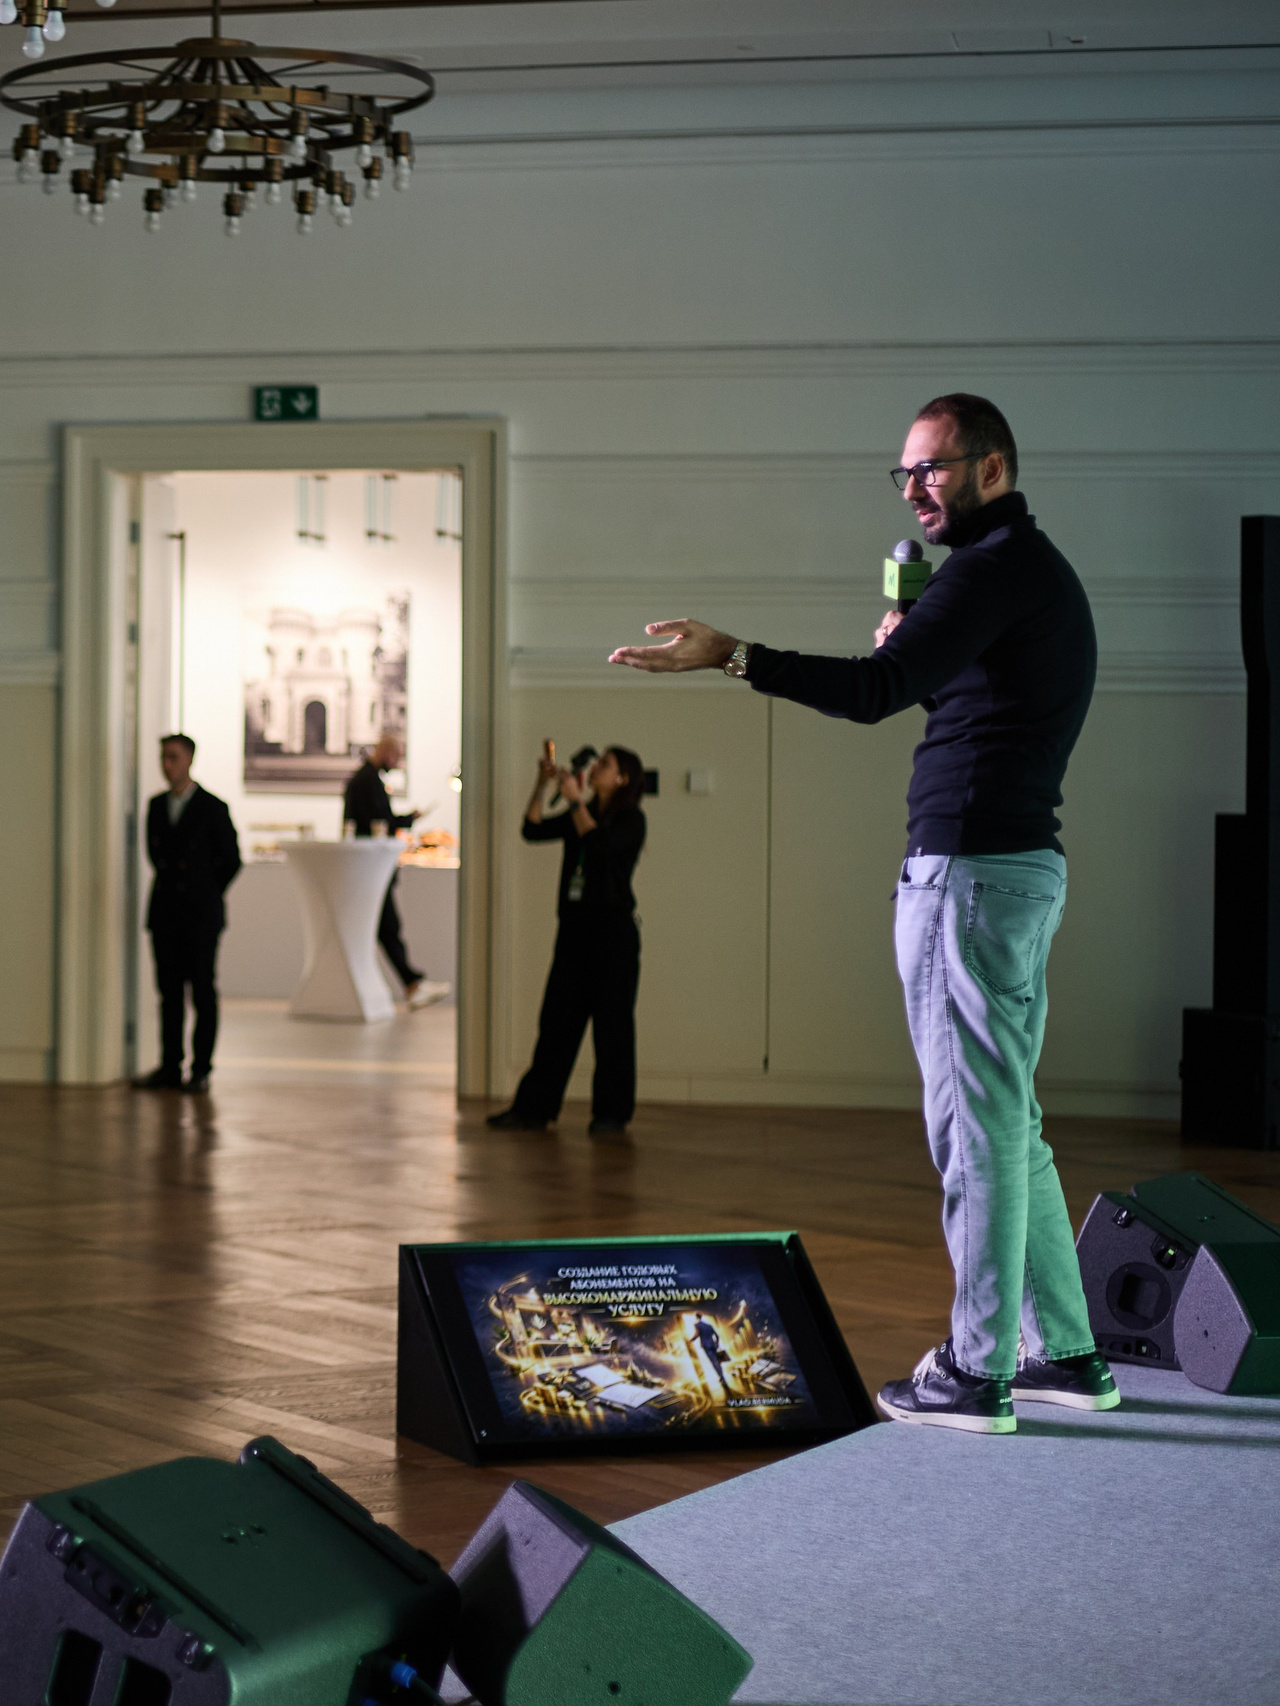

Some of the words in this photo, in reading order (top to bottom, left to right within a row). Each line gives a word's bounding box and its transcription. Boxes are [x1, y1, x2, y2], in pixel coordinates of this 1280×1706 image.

[557, 1265, 620, 1278] СОЗДАНИЕ
[622, 1264, 677, 1277] ГОДОВЫХ
[570, 1277, 656, 1290] АБОНЕМЕНТОВ
[658, 1277, 676, 1287] НА
[543, 1287, 718, 1306] ВЫСОКОМАРЖИНАЛЬНУЮ
[608, 1303, 665, 1317] УСЛУГУ
